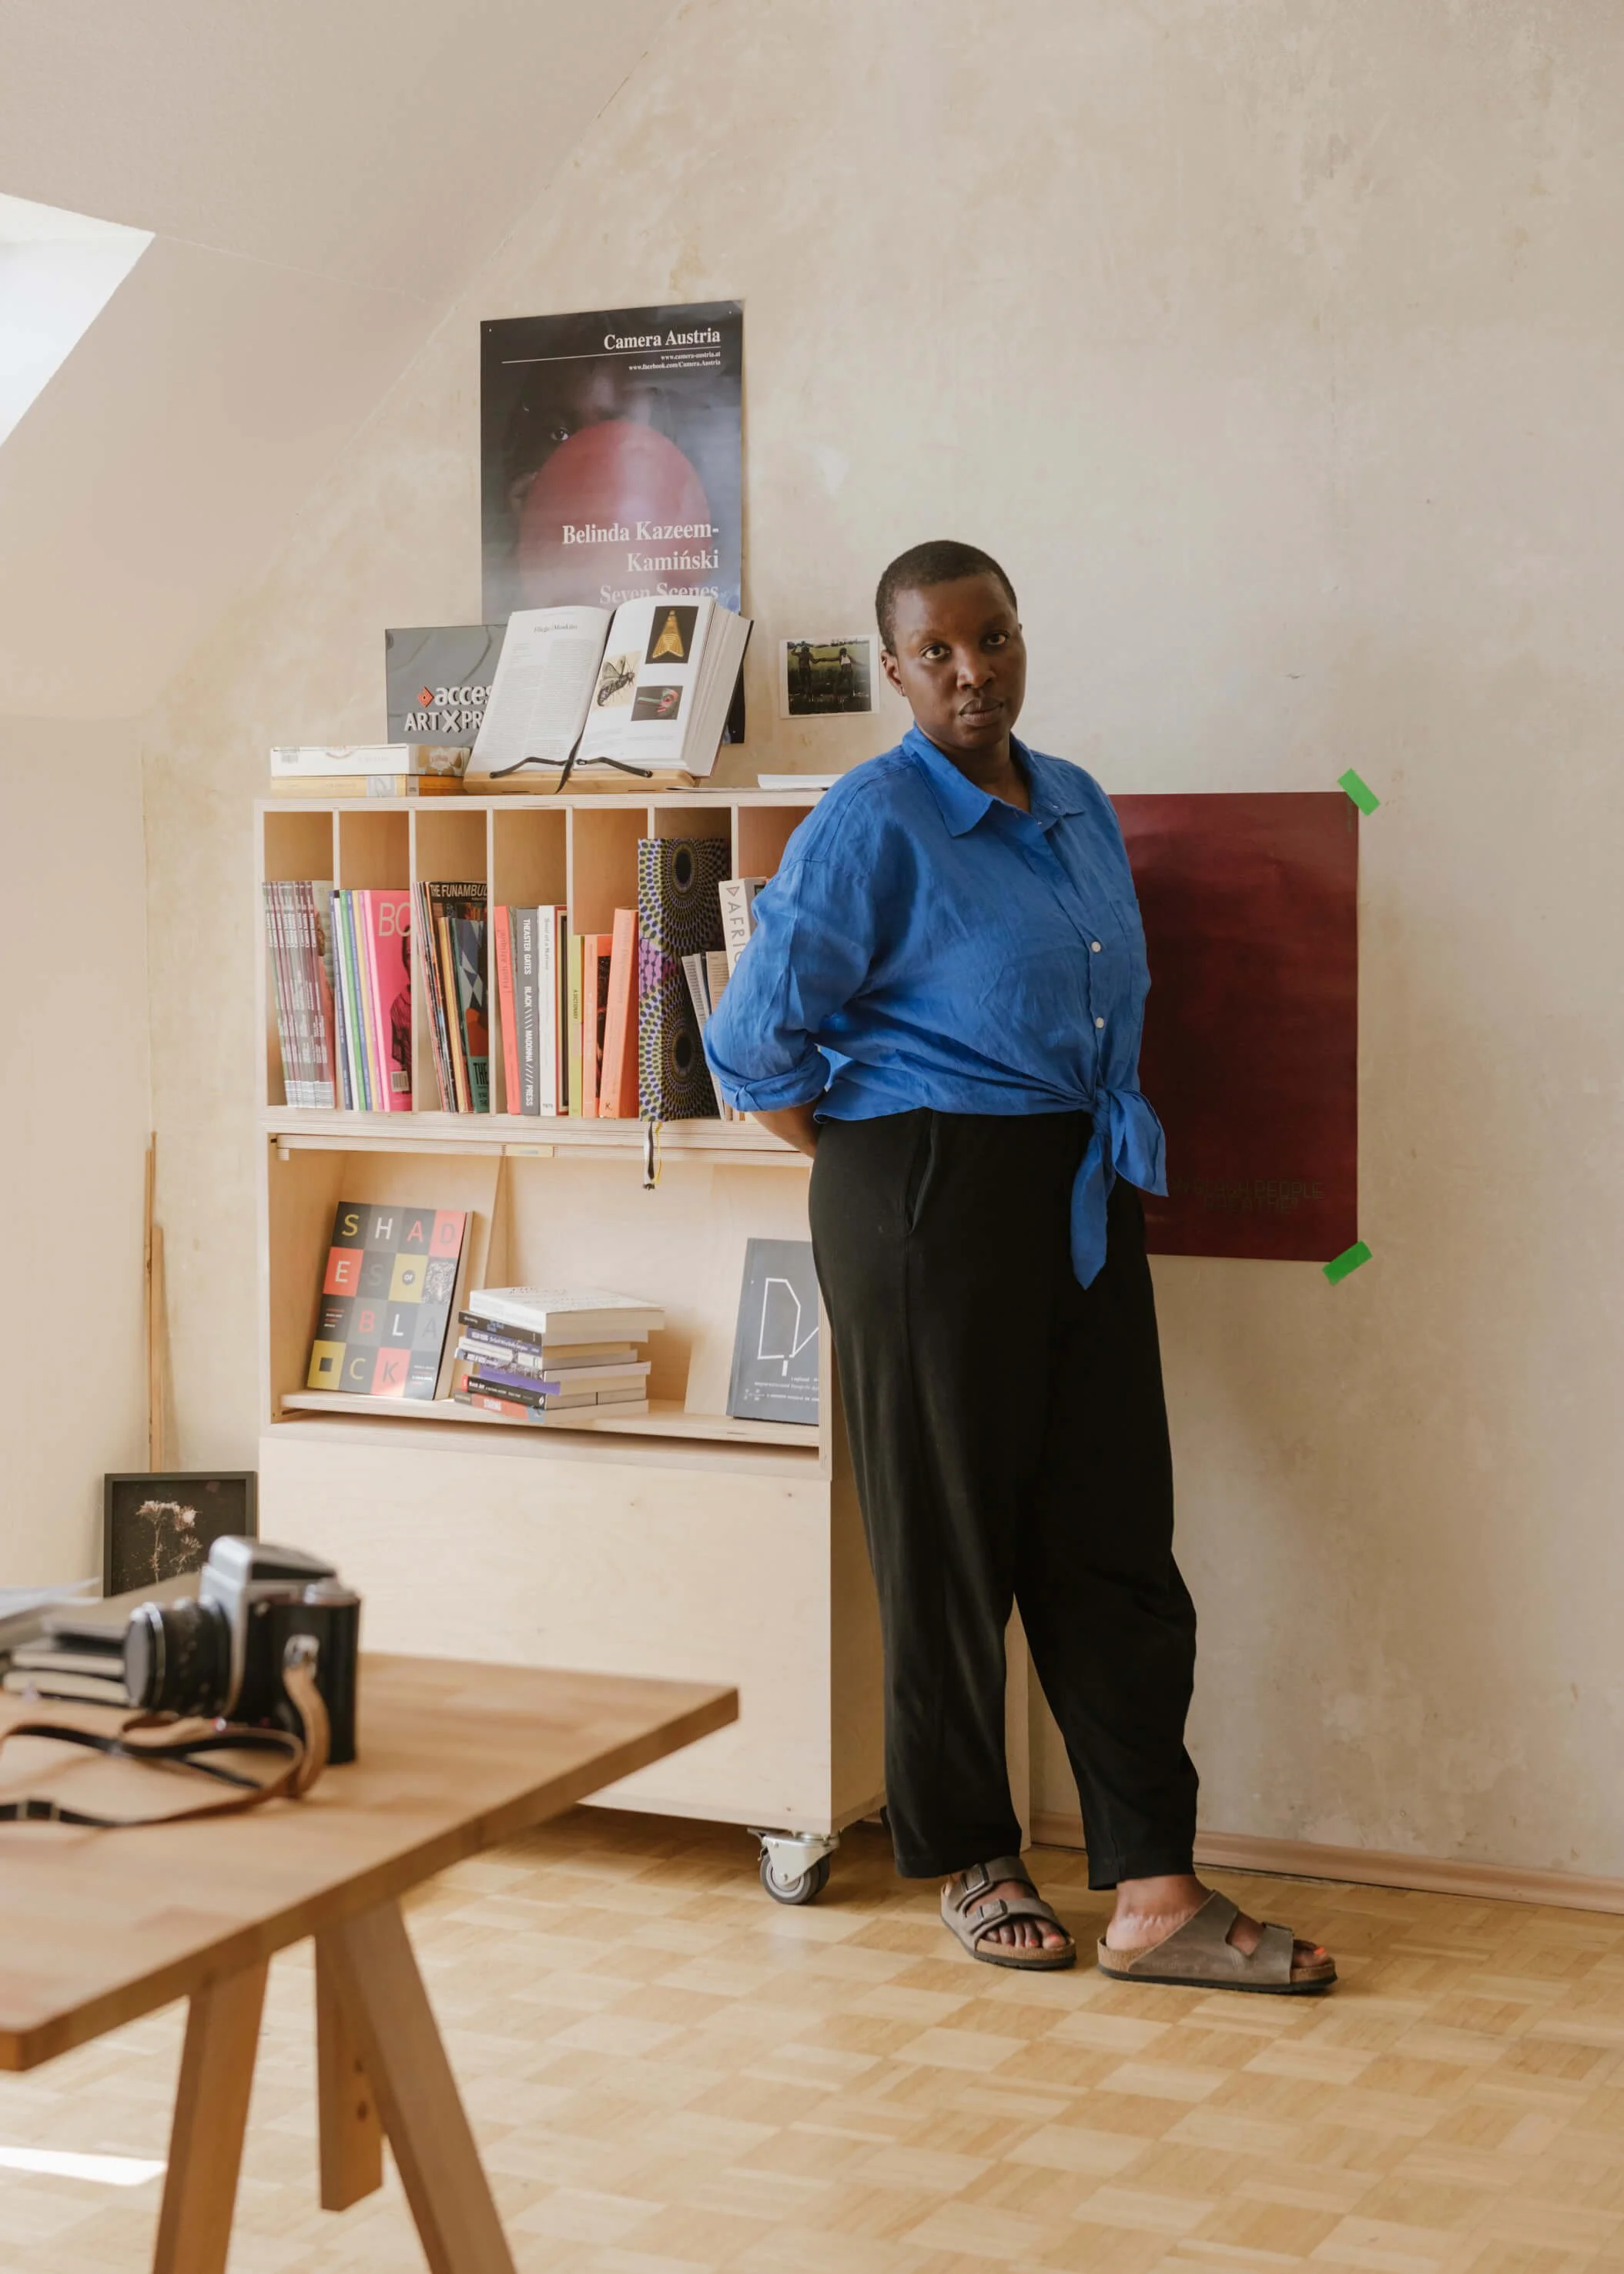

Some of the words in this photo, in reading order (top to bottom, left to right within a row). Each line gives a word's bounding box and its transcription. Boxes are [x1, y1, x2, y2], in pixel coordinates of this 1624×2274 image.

[604, 333, 661, 350] Camera
[665, 327, 721, 346] Austria
[661, 351, 721, 360] www.camera-austria.at
[562, 523, 630, 544] Belinda
[636, 521, 718, 540] Kazeem-
[627, 549, 718, 571] Kamiński
[599, 585, 650, 604] Seven
[523, 919, 531, 951] THEASTER
[524, 986, 532, 1008] BLACK
[524, 1030, 533, 1063] MADONNA
[525, 1084, 534, 1107] PRESS
